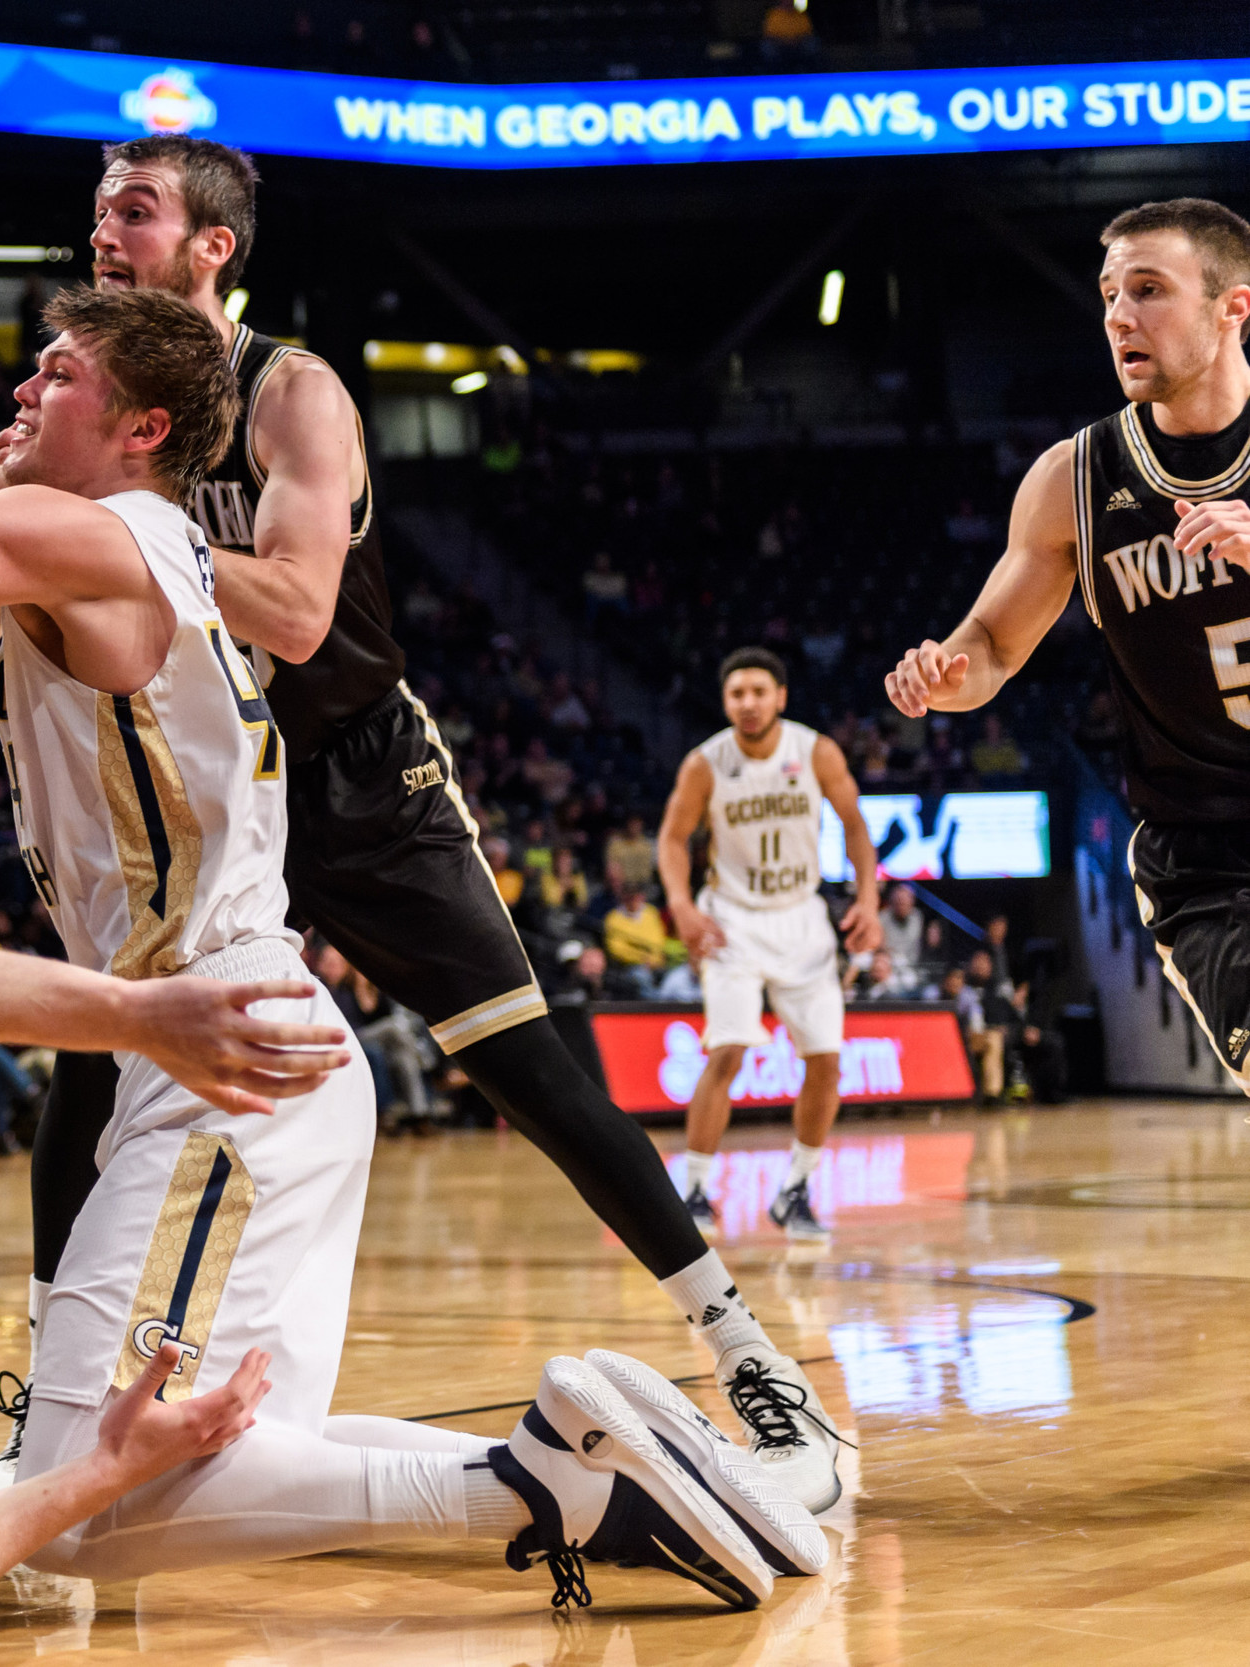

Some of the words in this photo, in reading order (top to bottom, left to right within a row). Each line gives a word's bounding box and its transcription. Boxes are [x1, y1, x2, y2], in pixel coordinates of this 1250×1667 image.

[334, 95, 488, 149] WHEN
[494, 97, 743, 149] GEORGIA
[752, 90, 938, 142] PLAYS,
[949, 86, 1069, 133] OUR
[724, 791, 811, 828] GEORGIA
[760, 829, 781, 866] 11
[746, 866, 809, 896] TECH
